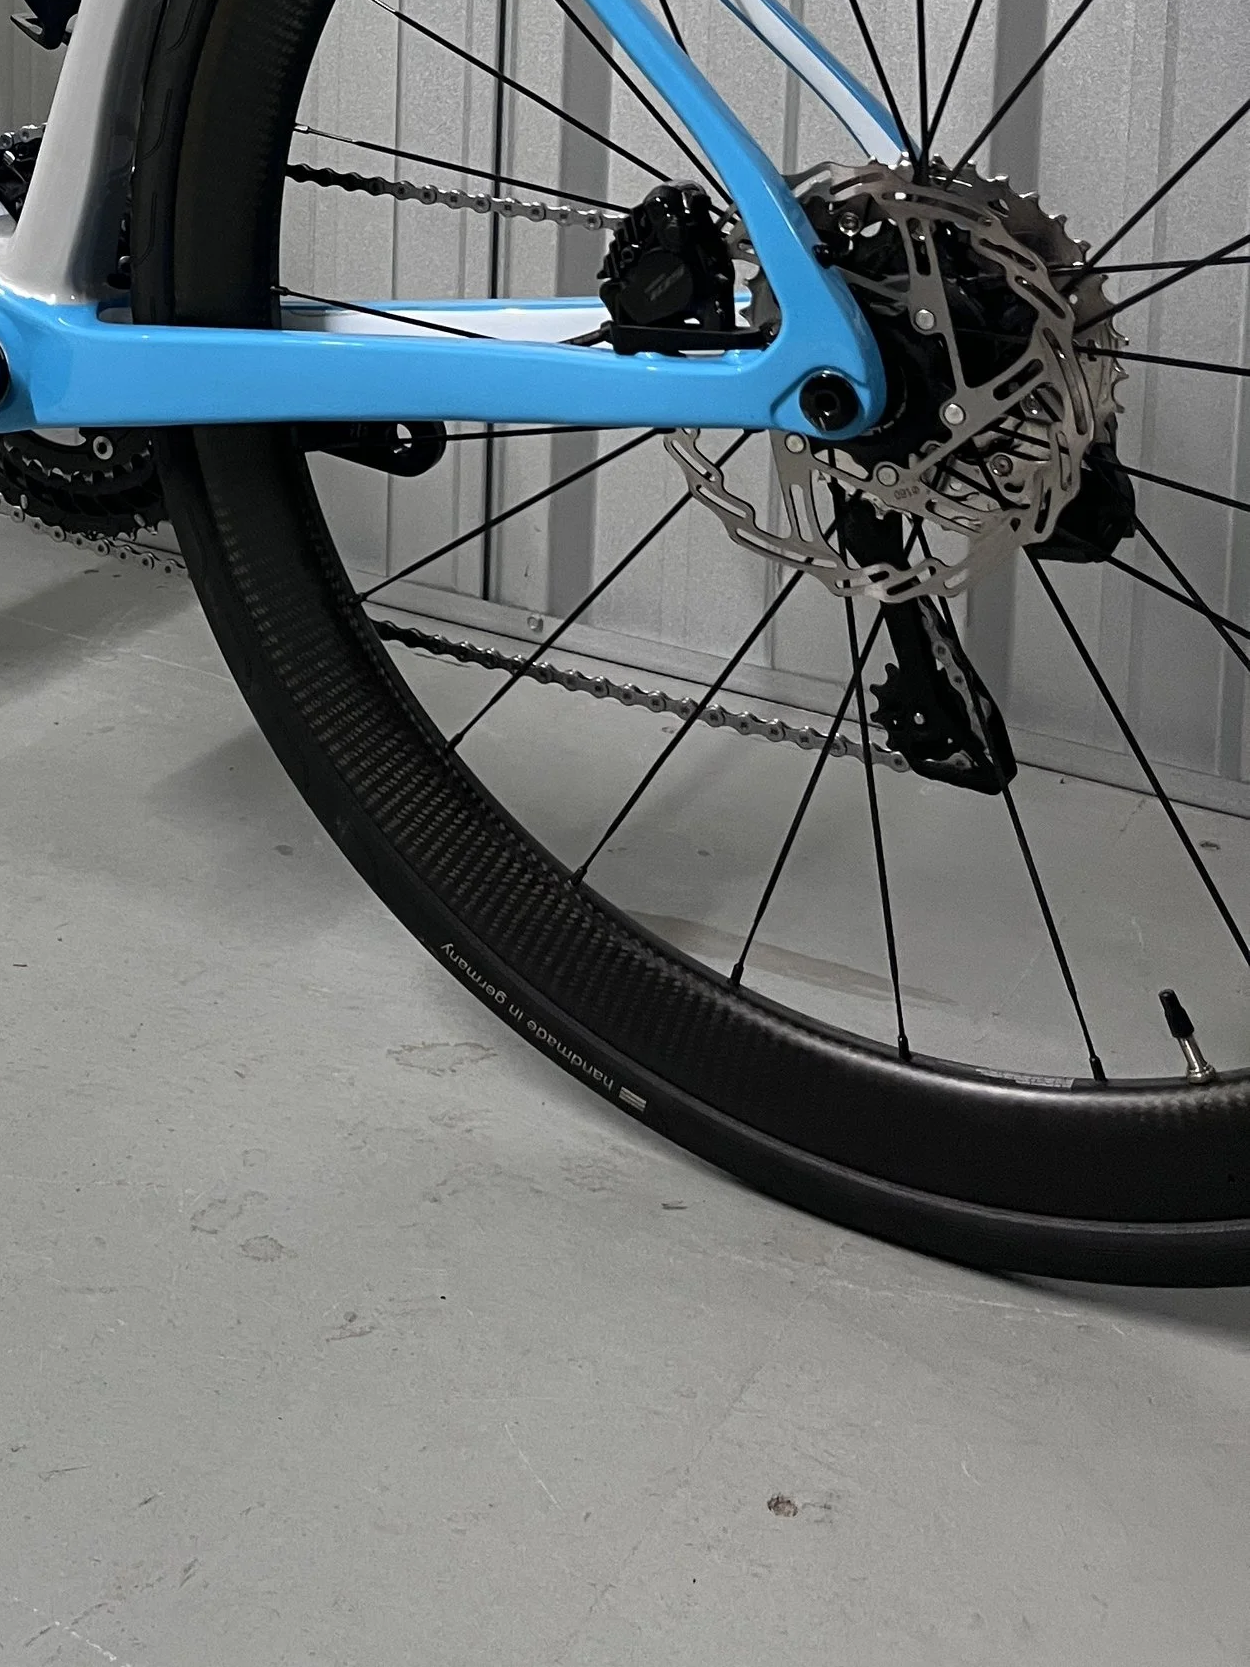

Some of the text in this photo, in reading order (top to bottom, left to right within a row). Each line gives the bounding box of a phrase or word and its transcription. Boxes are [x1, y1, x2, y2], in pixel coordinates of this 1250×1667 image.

[440, 942, 614, 1091] handmade in germany
